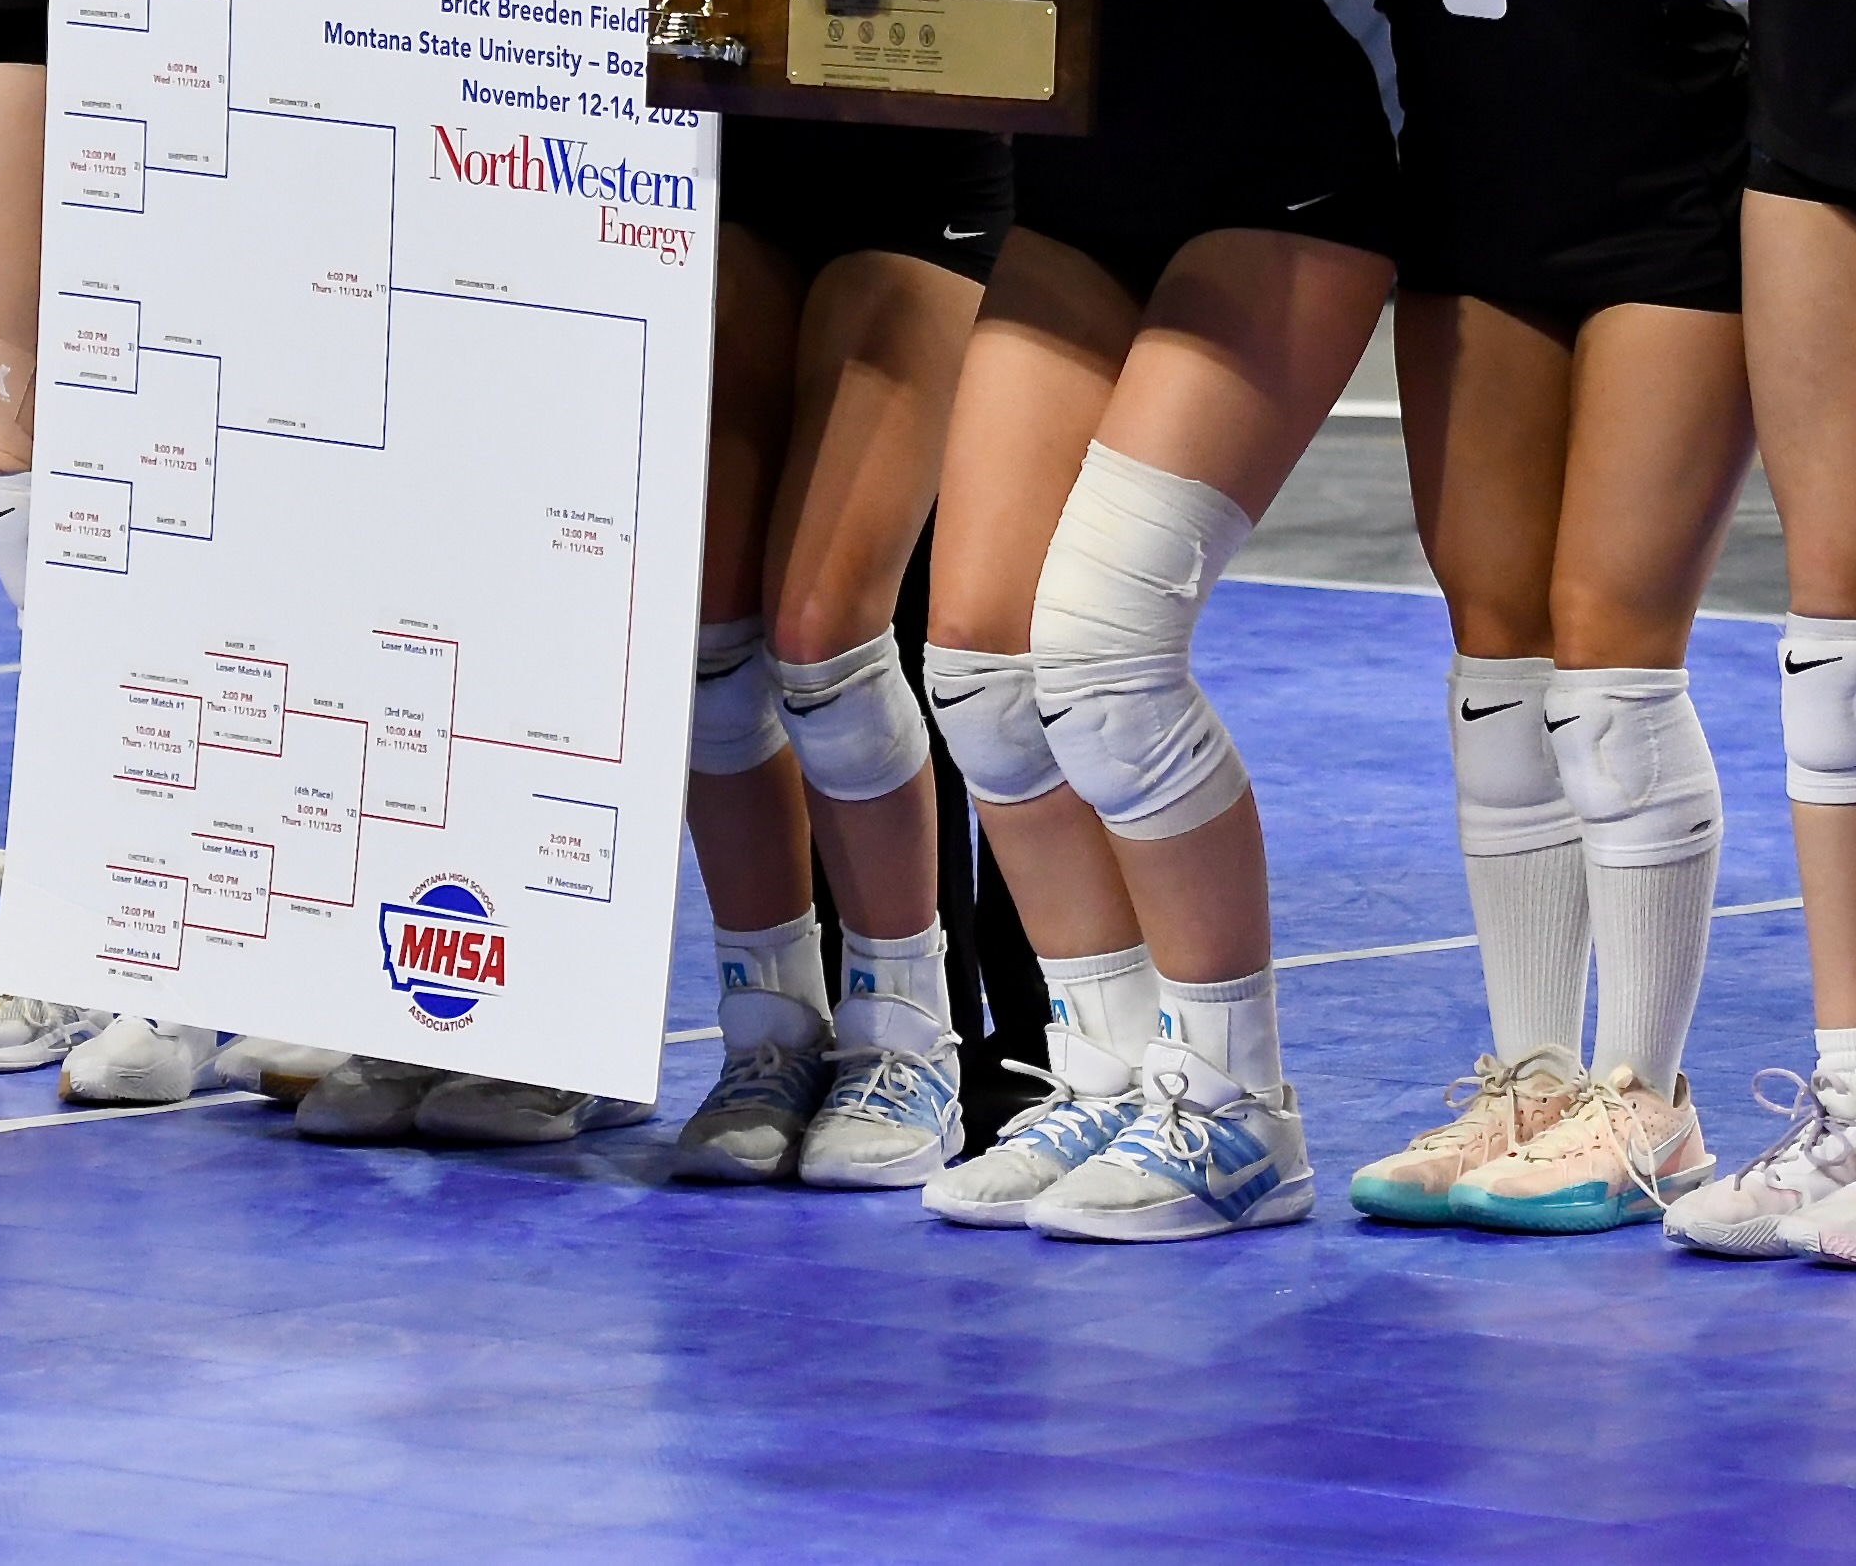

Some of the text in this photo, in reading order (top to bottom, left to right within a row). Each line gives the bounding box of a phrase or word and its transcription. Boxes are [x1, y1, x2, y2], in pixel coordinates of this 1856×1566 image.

[324, 20, 647, 78] Montana State University Boz
[184, 64, 198, 74] PM
[153, 74, 171, 85] Wed
[461, 78, 571, 113] November
[577, 91, 641, 126] 12-14,
[103, 151, 116, 162] PM
[69, 161, 87, 172] Wed
[429, 124, 697, 212] NorthWestern
[598, 205, 696, 267] Energy
[345, 273, 358, 283] PM
[94, 332, 108, 342] PM
[63, 341, 81, 353] Wed
[172, 445, 185, 456] PM
[86, 513, 99, 523] PM
[240, 692, 253, 703] PM
[568, 836, 582, 848] PM
[225, 875, 239, 886] PM
[408, 872, 496, 917] MONTANA HIGH SCHOOL
[142, 908, 156, 919] PM
[397, 923, 505, 987] MHSA
[408, 1004, 474, 1033] ASSOCIATION
